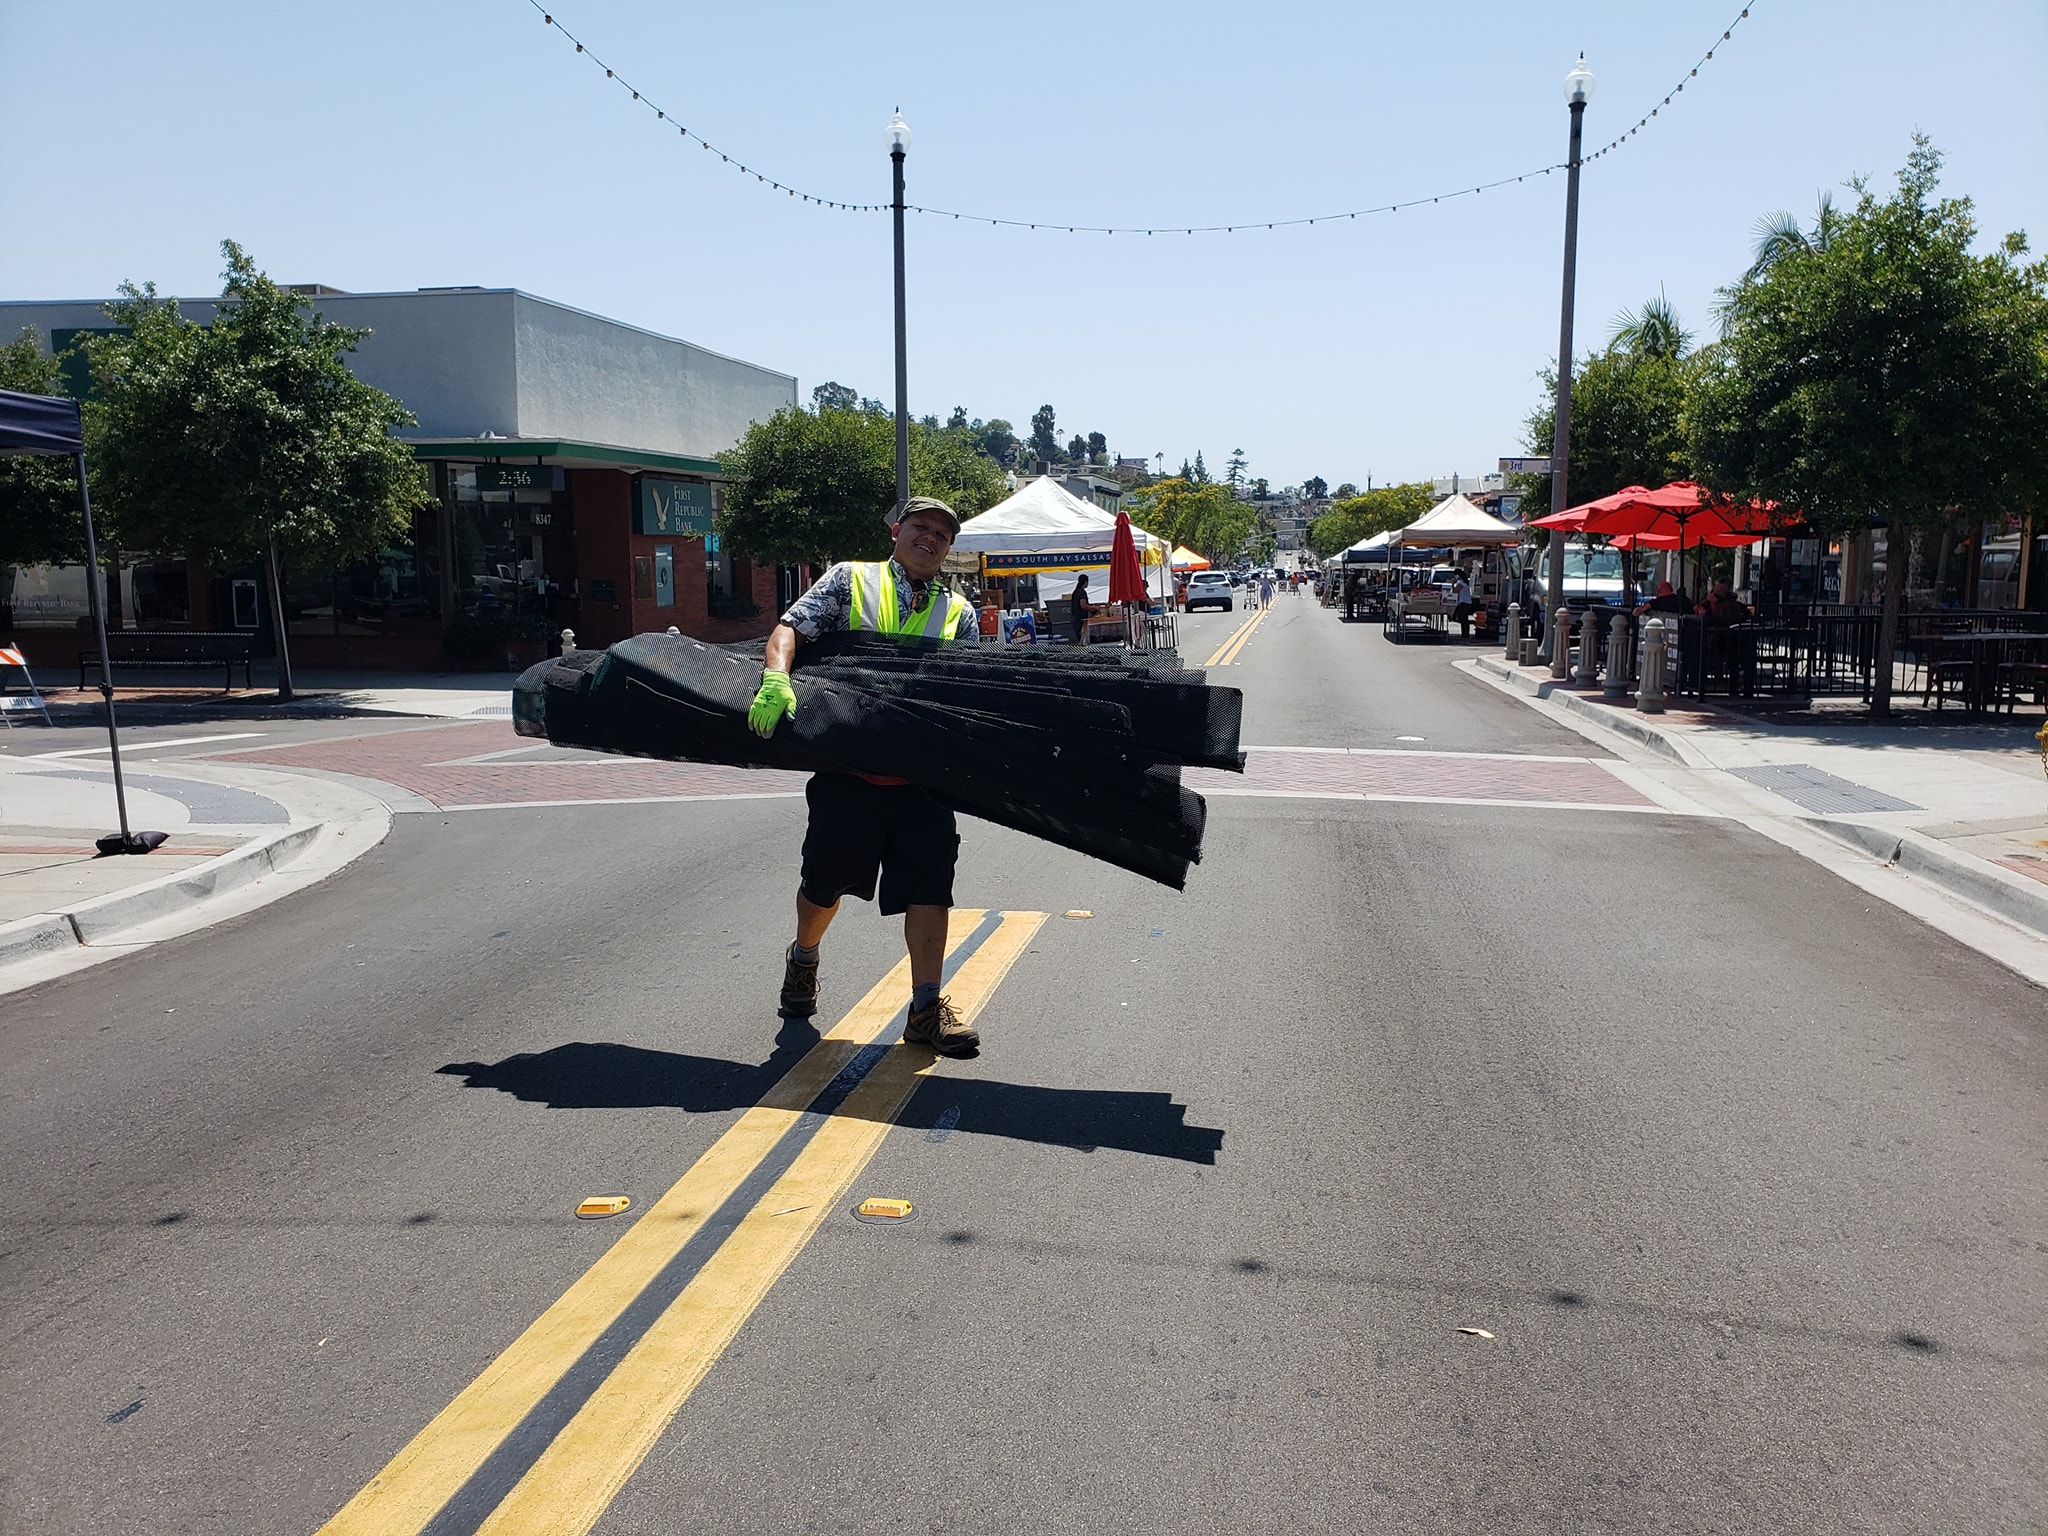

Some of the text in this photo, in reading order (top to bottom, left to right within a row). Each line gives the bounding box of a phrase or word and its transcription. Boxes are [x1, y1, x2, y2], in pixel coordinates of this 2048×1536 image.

[1509, 460, 1523, 470] 3rd
[499, 471, 531, 487] 2:36
[673, 485, 691, 500] FIRST
[674, 501, 704, 517] REPUBLIC
[535, 513, 552, 525] 8347
[1015, 556, 1048, 564] SOUTH
[1074, 553, 1111, 561] SALSAS
